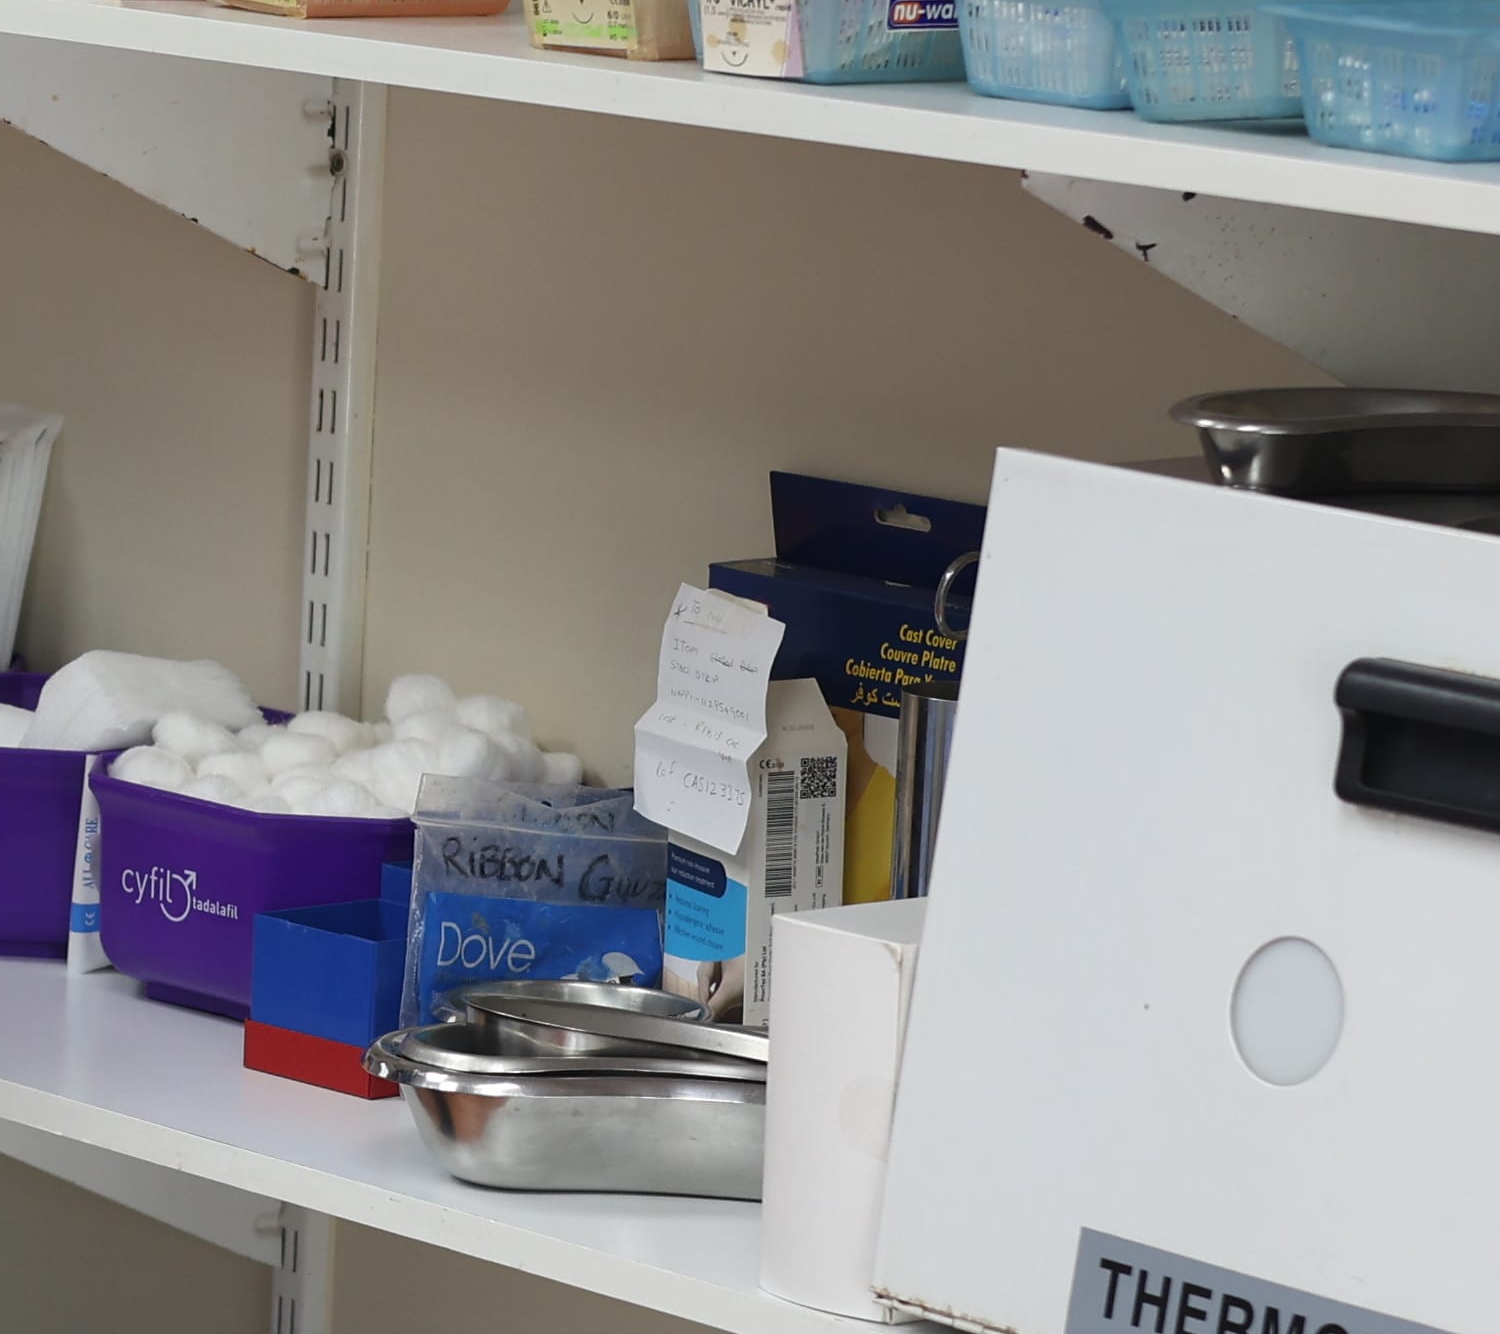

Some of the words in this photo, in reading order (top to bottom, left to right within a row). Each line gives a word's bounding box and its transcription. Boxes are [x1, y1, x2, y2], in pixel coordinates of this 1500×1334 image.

[900, 624, 923, 644] Cast
[925, 629, 958, 651] Cover
[845, 658, 891, 683] Cobierta
[880, 642, 919, 666] Couvre
[921, 650, 957, 674] Platre
[121, 866, 172, 905] cyfil
[192, 895, 239, 921] tadalafil
[437, 921, 536, 973] Dove
